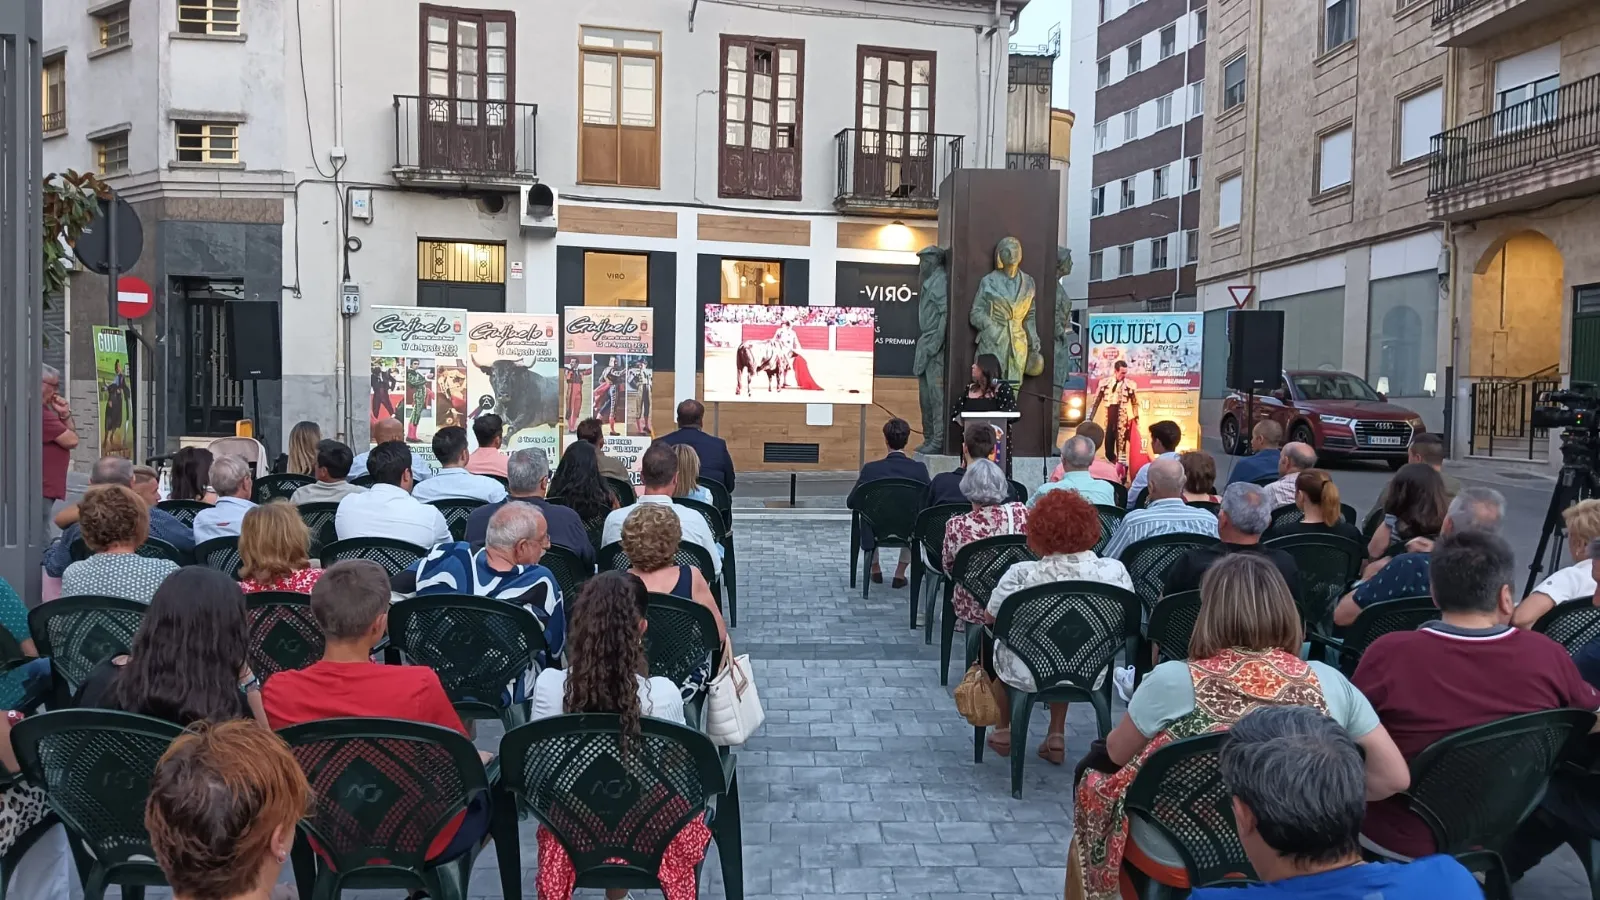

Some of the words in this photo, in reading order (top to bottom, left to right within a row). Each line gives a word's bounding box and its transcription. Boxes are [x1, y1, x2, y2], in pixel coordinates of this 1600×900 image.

[373, 314, 451, 341] Guijuelo
[469, 322, 544, 348] Guijuelo
[567, 316, 638, 341] Guijuelo
[1091, 322, 1182, 344] GUIJUELO
[401, 343, 410, 351] 17
[885, 338, 916, 346] PREMIUM
